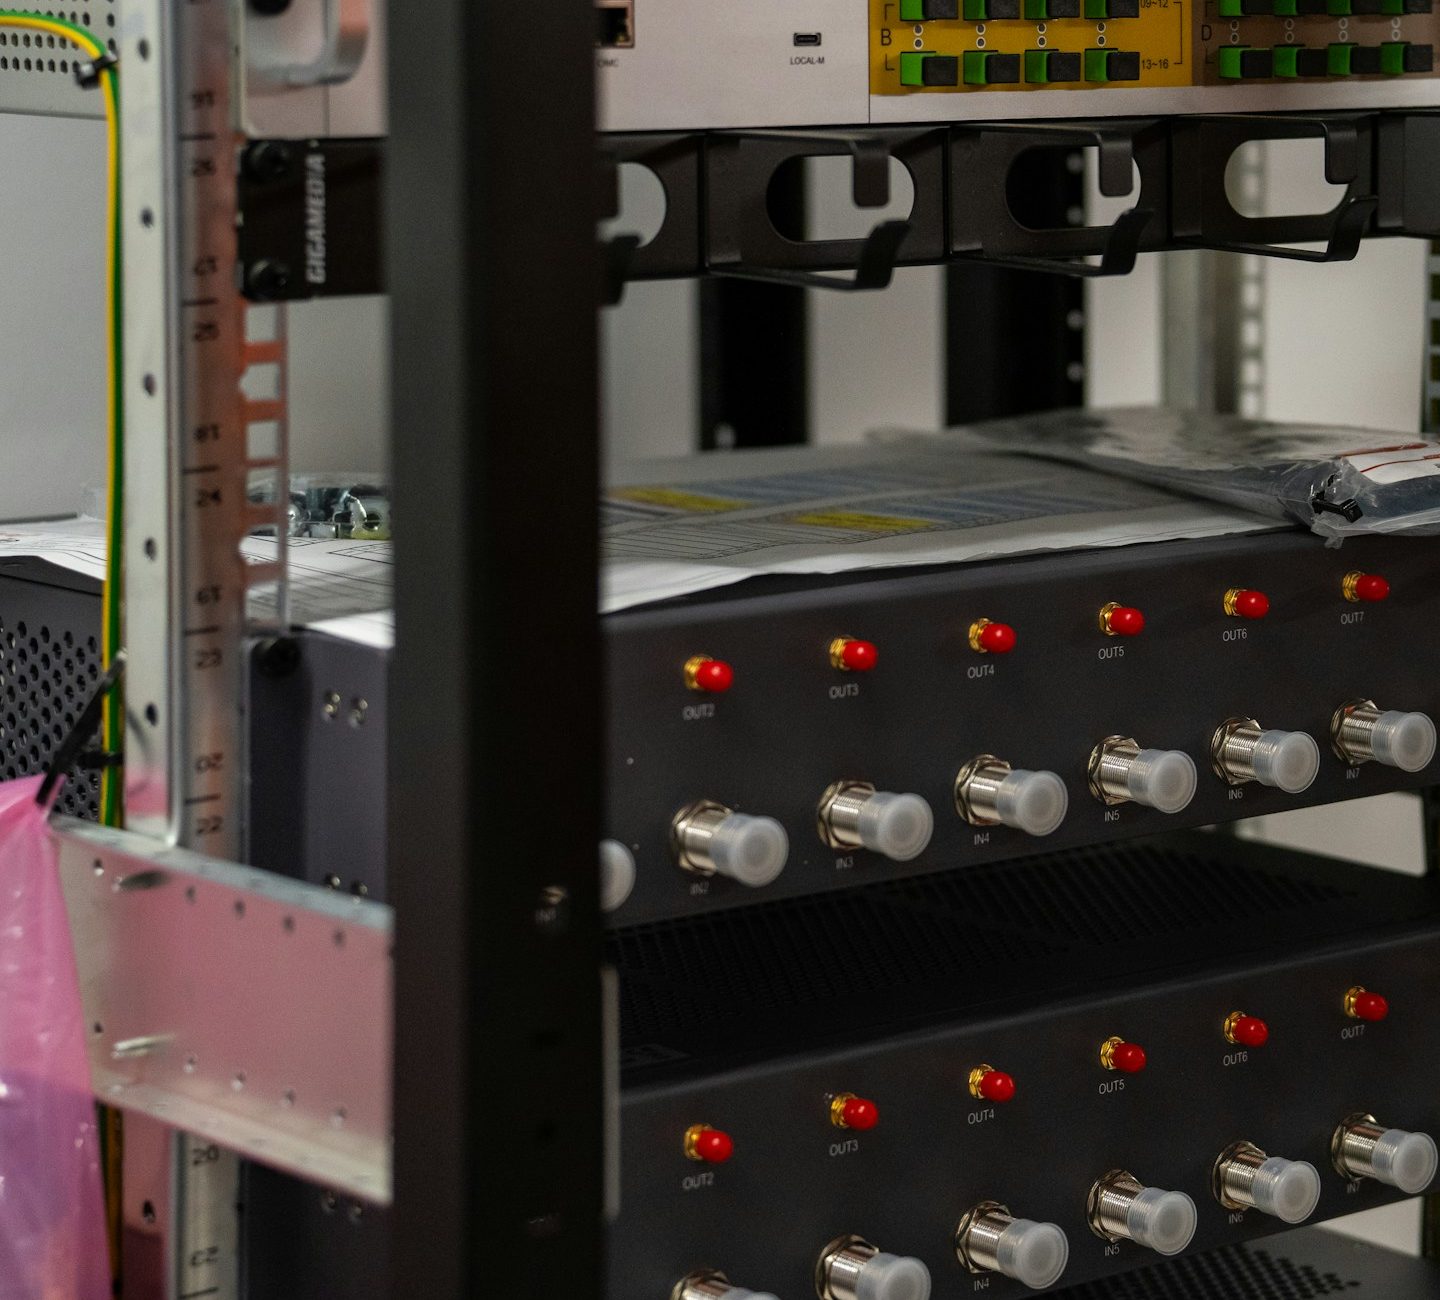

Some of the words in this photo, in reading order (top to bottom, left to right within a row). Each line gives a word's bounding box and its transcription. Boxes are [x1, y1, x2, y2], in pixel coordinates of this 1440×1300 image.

[881, 28, 893, 46] B
[1202, 24, 1212, 41] D
[790, 57, 825, 65] LOCAL-M
[1142, 59, 1169, 69] 13~16
[303, 156, 326, 284] GIGAMEDIA
[1340, 611, 1365, 626] OUT7
[1222, 628, 1248, 642] OUT6
[1098, 646, 1125, 661] OUT5
[968, 664, 995, 679] OUT4
[829, 683, 859, 699] OUT3
[683, 703, 715, 720] OUT2
[1346, 768, 1360, 780] IN7
[1228, 788, 1243, 801] IN6
[1104, 809, 1120, 822] IN5
[974, 832, 990, 846] IN4
[836, 856, 853, 870] IN3
[1341, 1025, 1365, 1040] OUT7
[1223, 1051, 1248, 1067] OUT6
[1099, 1080, 1125, 1094] OUT5
[968, 1109, 995, 1125] OUT4
[193, 1145, 219, 1166] 20
[829, 1140, 859, 1156] OUT3
[683, 1174, 714, 1190] OUT2
[1346, 1181, 1360, 1193] IN7
[1228, 1212, 1243, 1225] IN6
[1104, 1243, 1120, 1256] IN5
[974, 1277, 989, 1291] IN4
